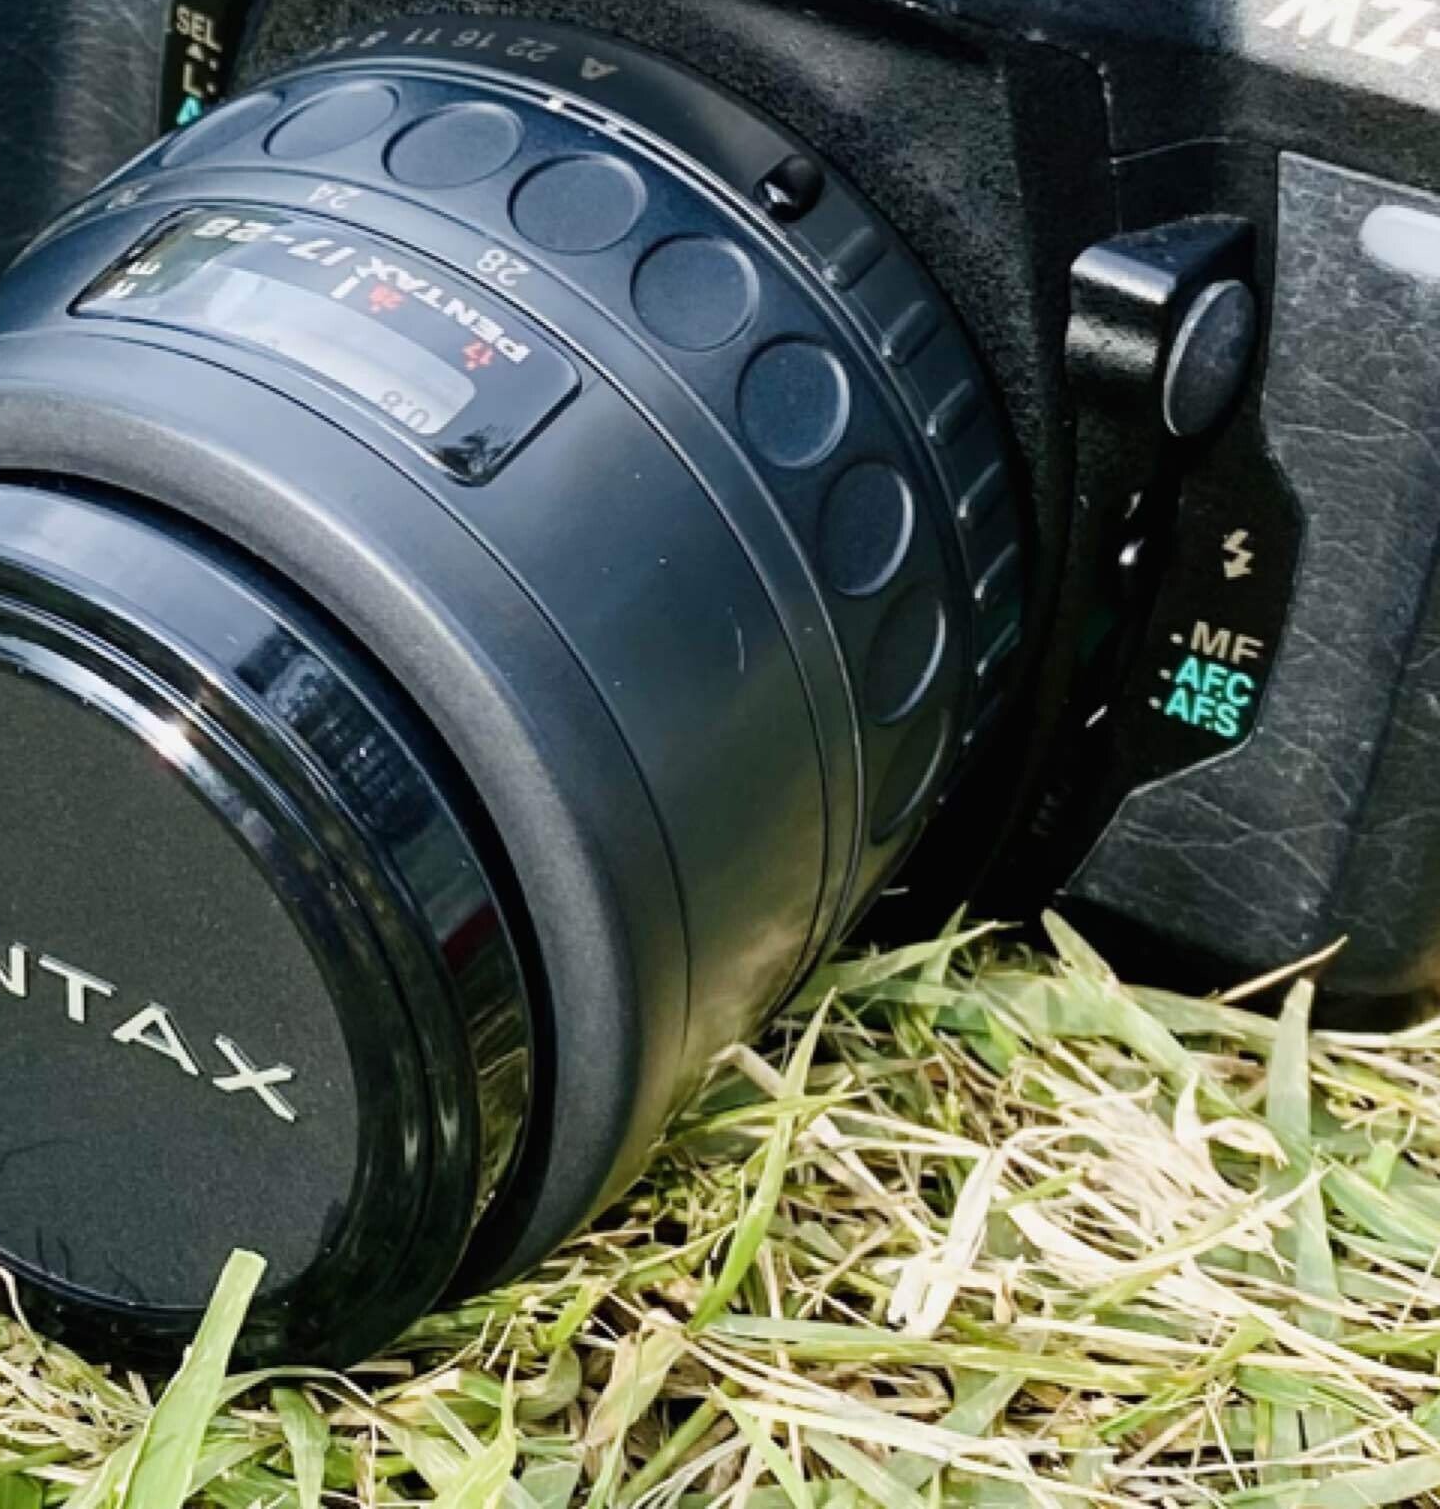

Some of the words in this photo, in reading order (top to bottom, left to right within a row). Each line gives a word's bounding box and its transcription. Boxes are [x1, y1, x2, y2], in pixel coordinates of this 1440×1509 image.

[176, 5, 222, 53] SEL
[506, 37, 559, 63] 22
[476, 247, 530, 288] 28
[354, 254, 532, 364] PENTAX
[1190, 619, 1265, 665] MF
